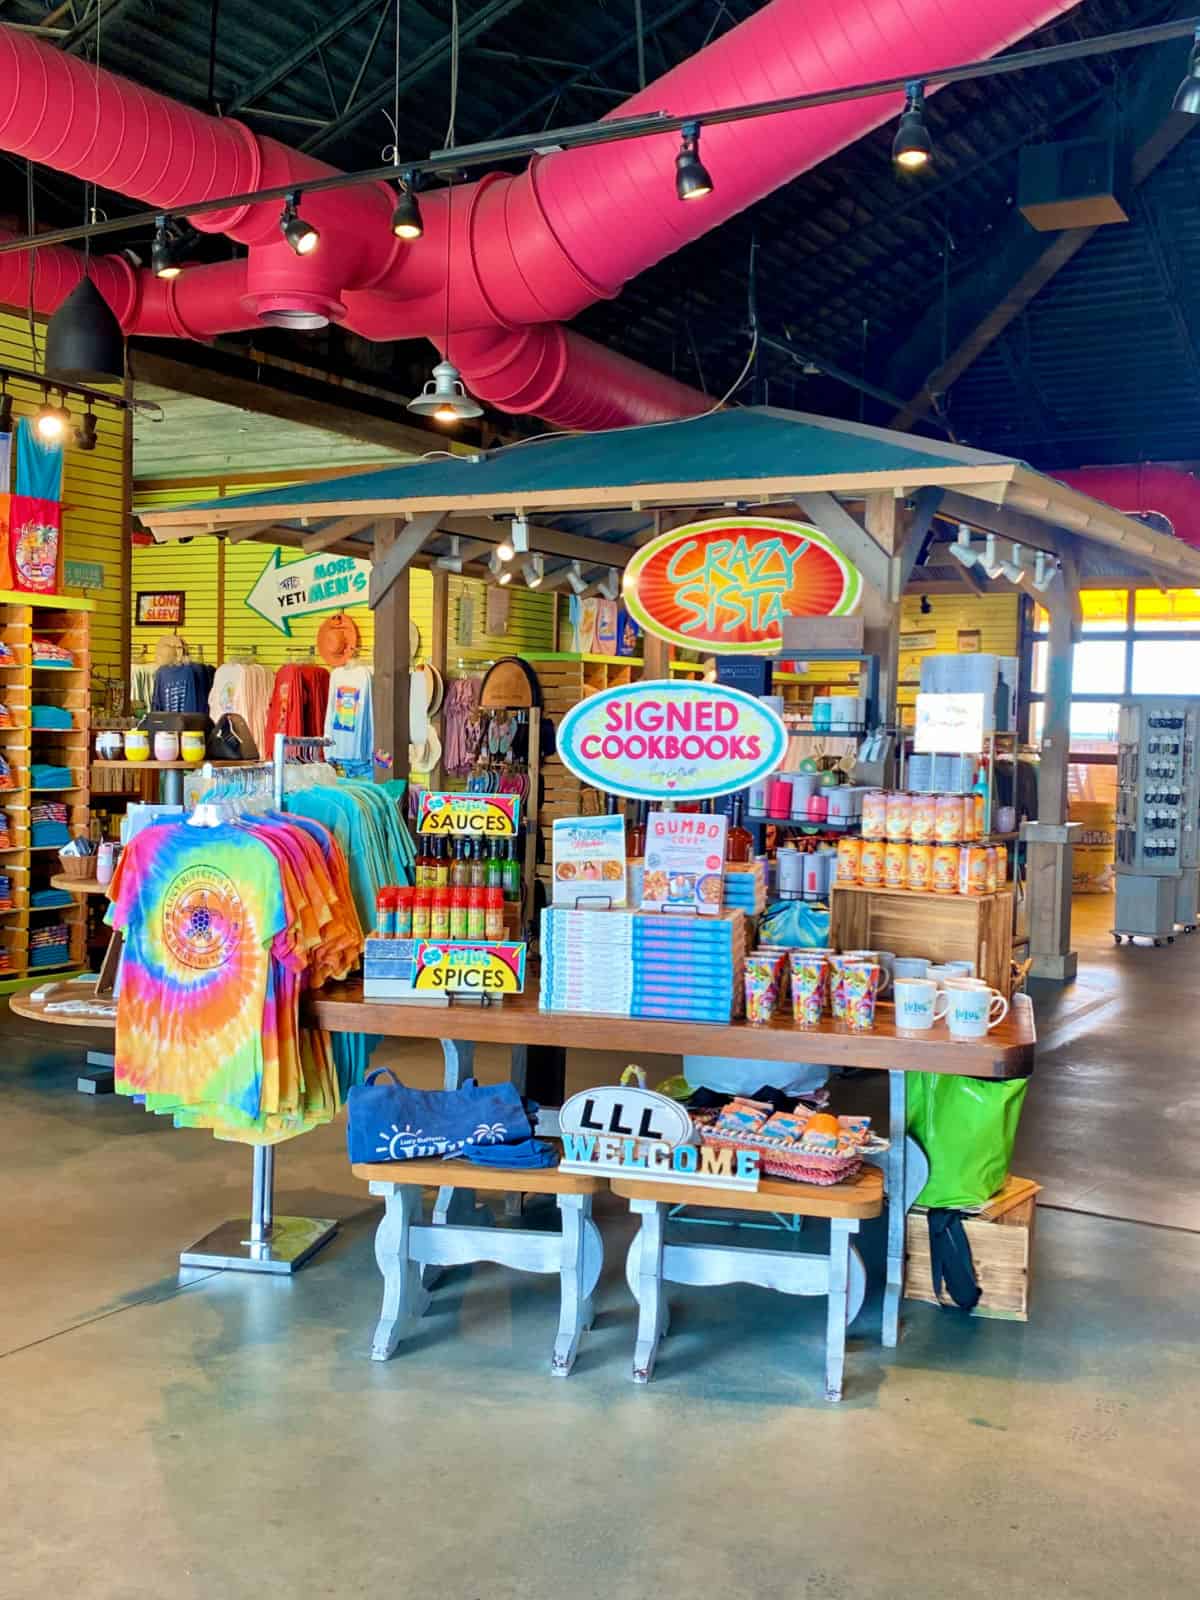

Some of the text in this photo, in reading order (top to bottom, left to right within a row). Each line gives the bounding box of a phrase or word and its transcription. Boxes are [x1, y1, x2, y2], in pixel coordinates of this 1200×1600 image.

[313, 556, 357, 580] MORE
[666, 535, 811, 591] CRAZY
[276, 590, 307, 608] YETI
[308, 571, 368, 604] MEN'S
[674, 582, 793, 635] SISTA
[604, 700, 740, 732] SIGNED
[580, 733, 762, 761] COOKBOOKS
[429, 813, 506, 831] SAUCES
[654, 818, 720, 839] GUMBO
[431, 966, 505, 988] SPICES
[560, 1133, 761, 1180] WELCOME
